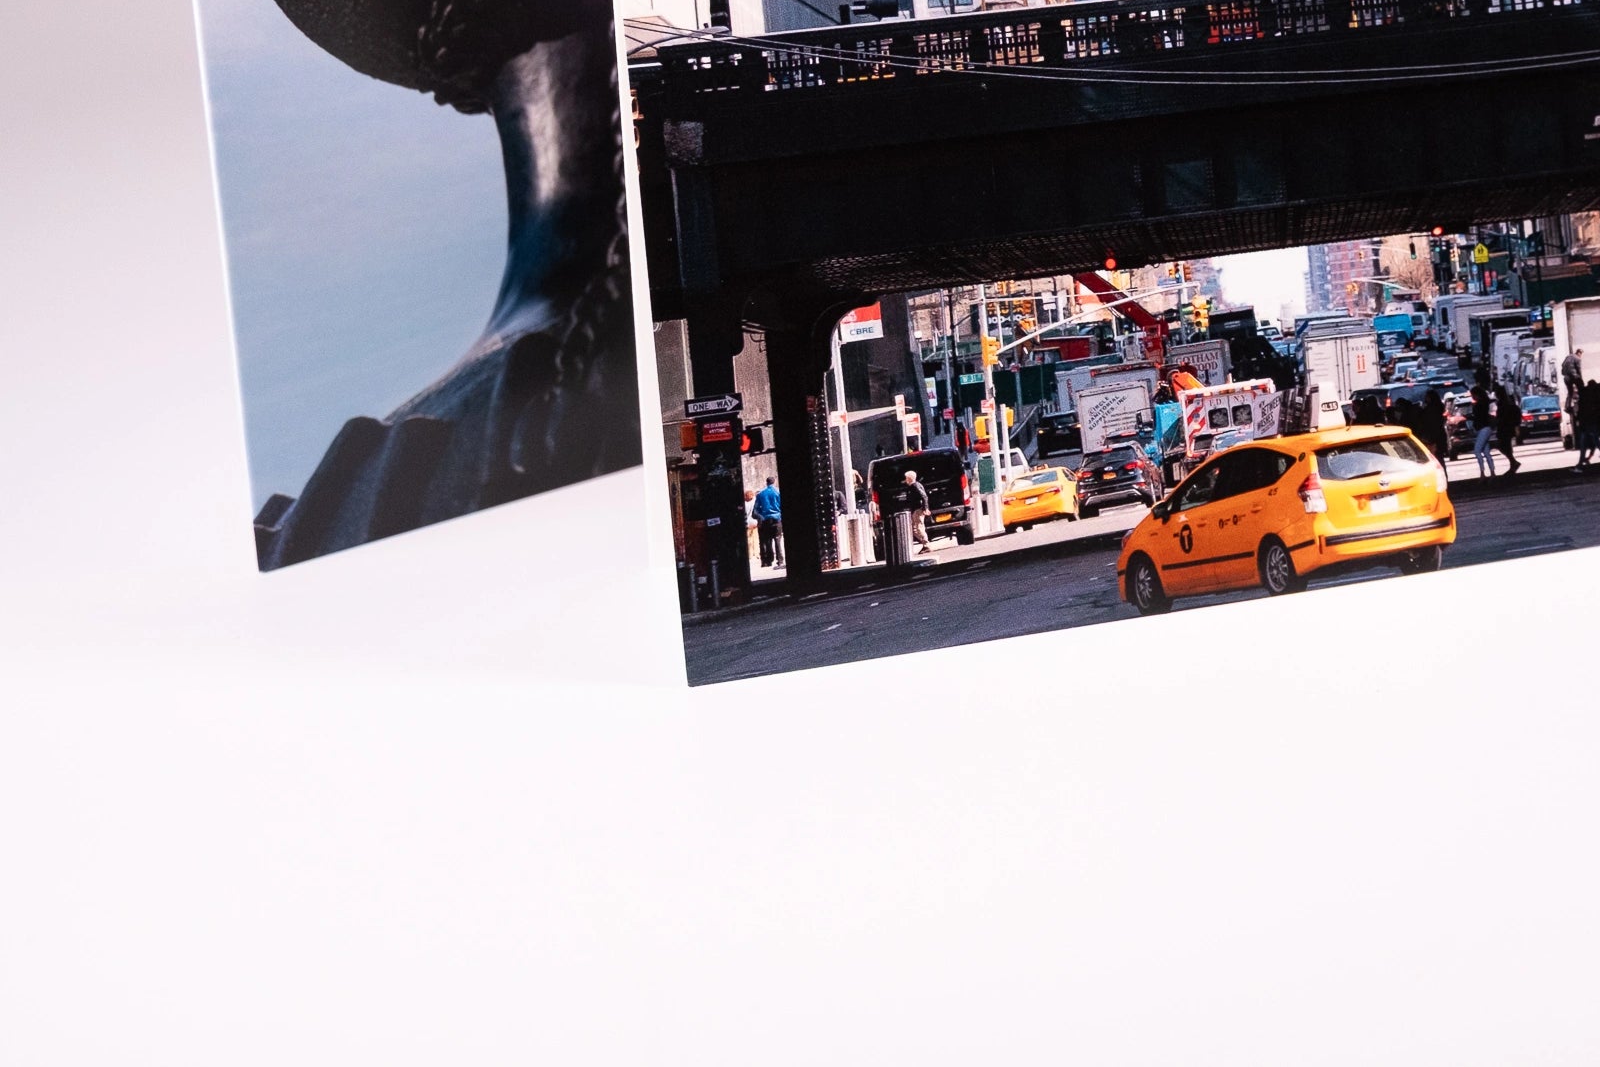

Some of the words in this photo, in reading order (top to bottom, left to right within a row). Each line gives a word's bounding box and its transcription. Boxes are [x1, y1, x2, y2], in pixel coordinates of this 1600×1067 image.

[850, 327, 874, 335] CBRE
[1175, 352, 1219, 364] GOTHAM
[692, 402, 710, 412] ONE
[716, 399, 734, 409] WAY
